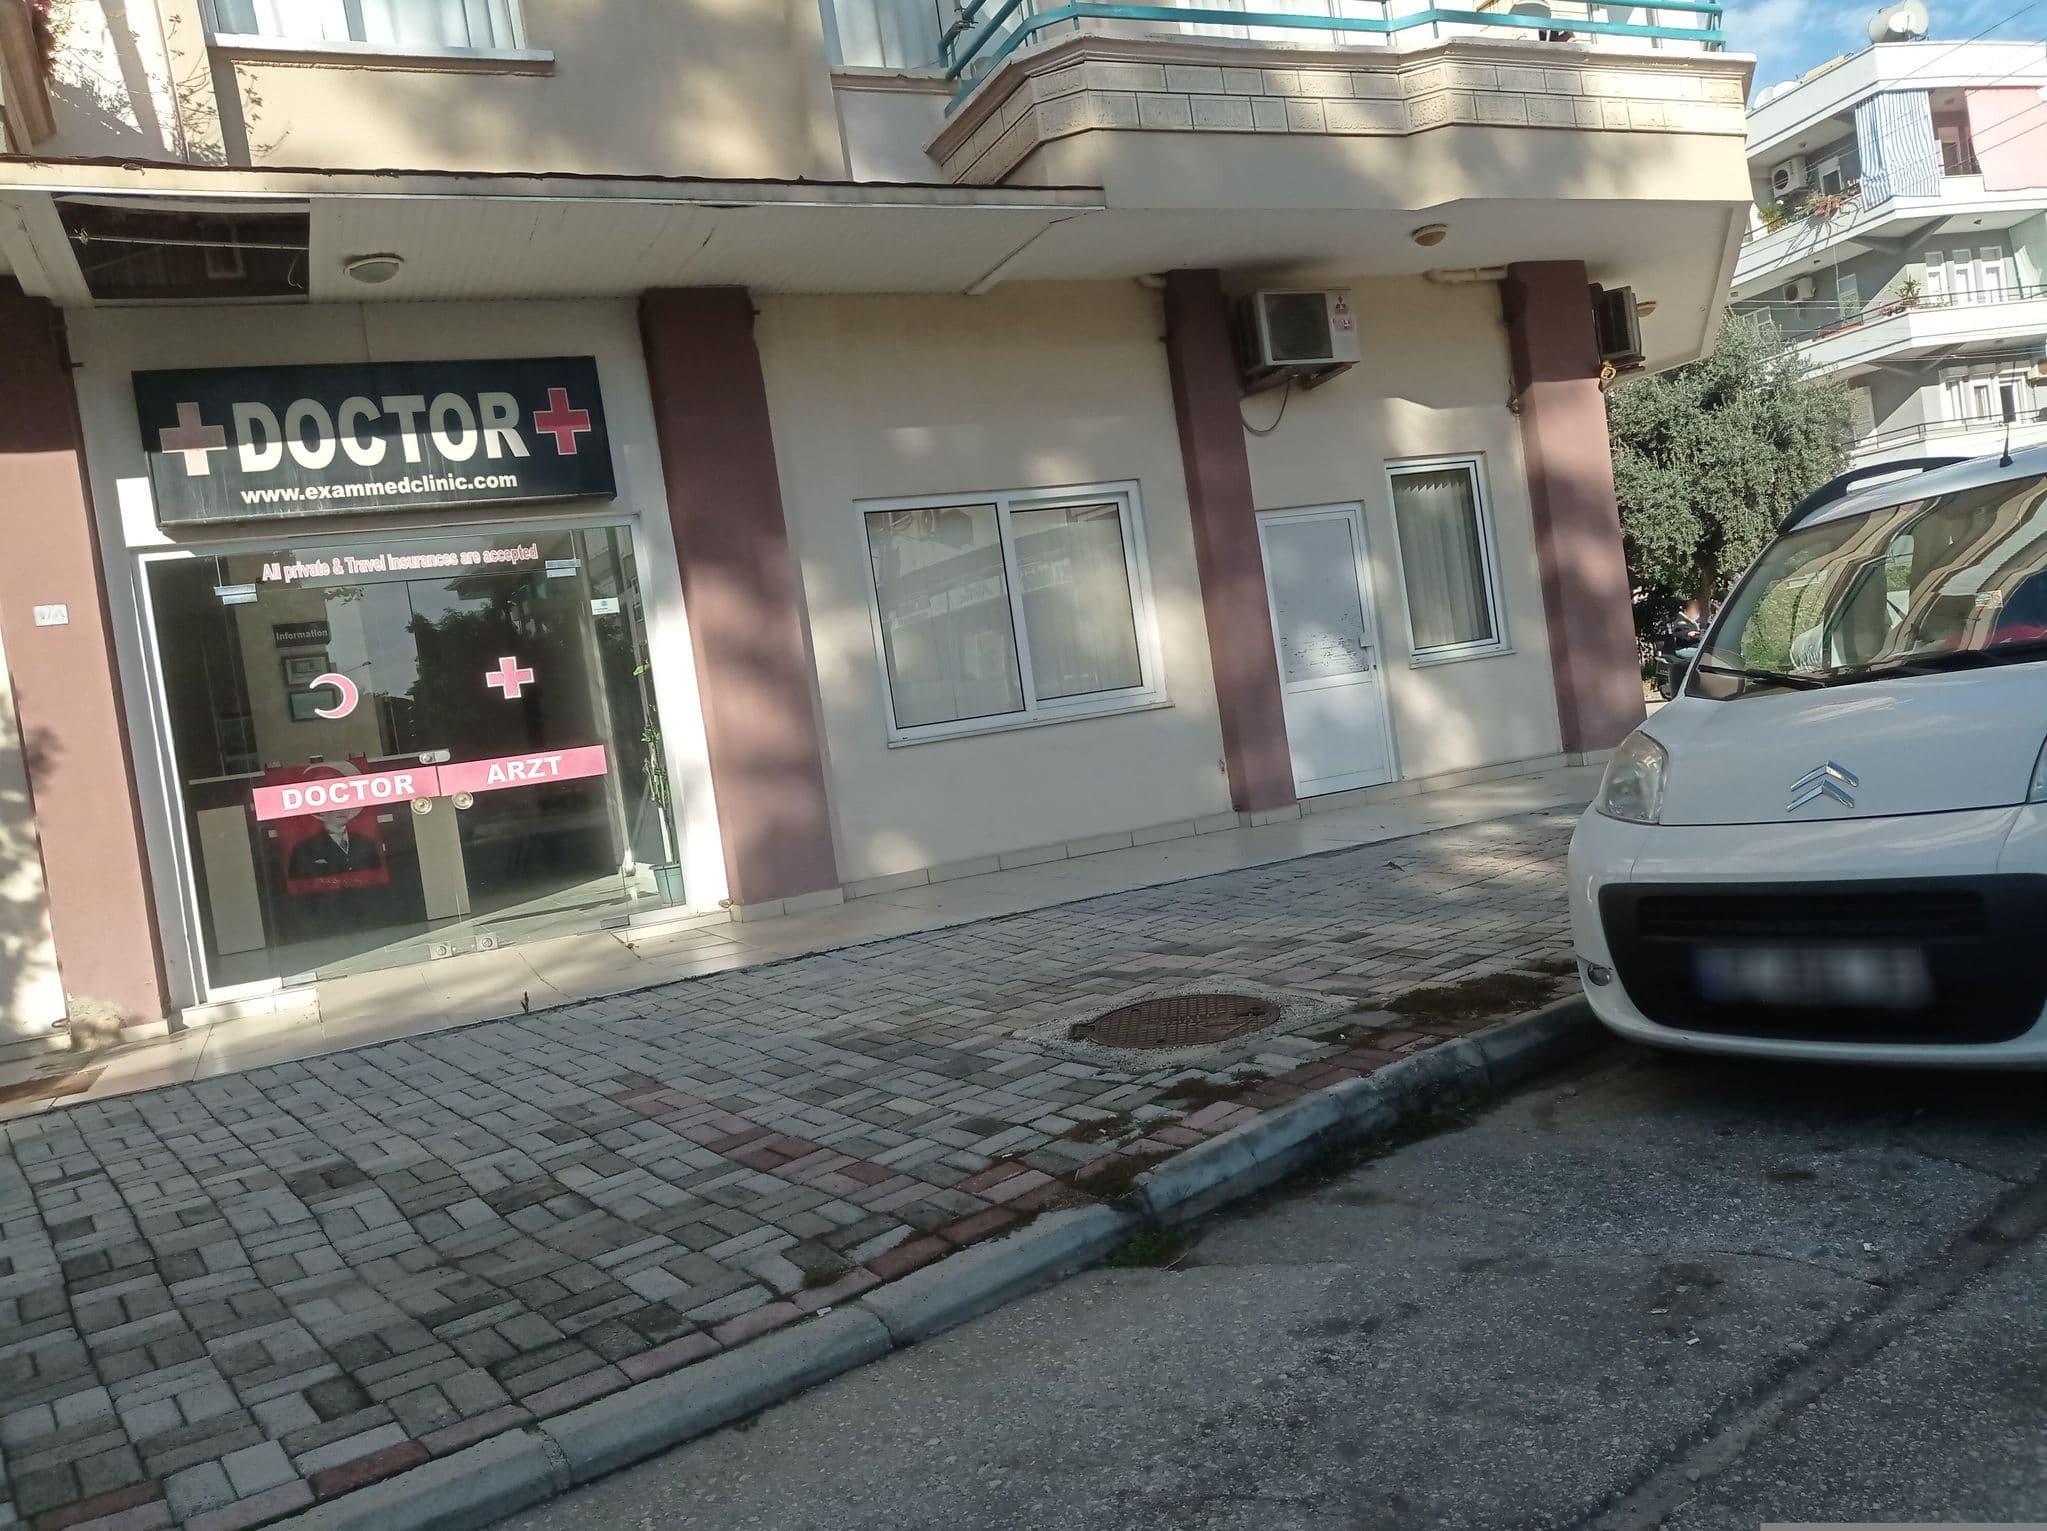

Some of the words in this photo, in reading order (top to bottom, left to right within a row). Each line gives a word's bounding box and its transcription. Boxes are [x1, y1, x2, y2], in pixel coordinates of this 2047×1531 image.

[232, 391, 531, 473] DOCTOR
[240, 473, 518, 504] www.exammedclinic.com
[262, 562, 282, 581] All
[283, 559, 331, 583] private
[332, 557, 345, 575] &
[344, 554, 386, 574] Travel
[387, 552, 458, 571] Insurances
[460, 550, 481, 565] are
[482, 543, 539, 565] accepted
[276, 629, 328, 640] Information
[486, 754, 562, 785] ARZT
[281, 773, 416, 812] DOCTOR
